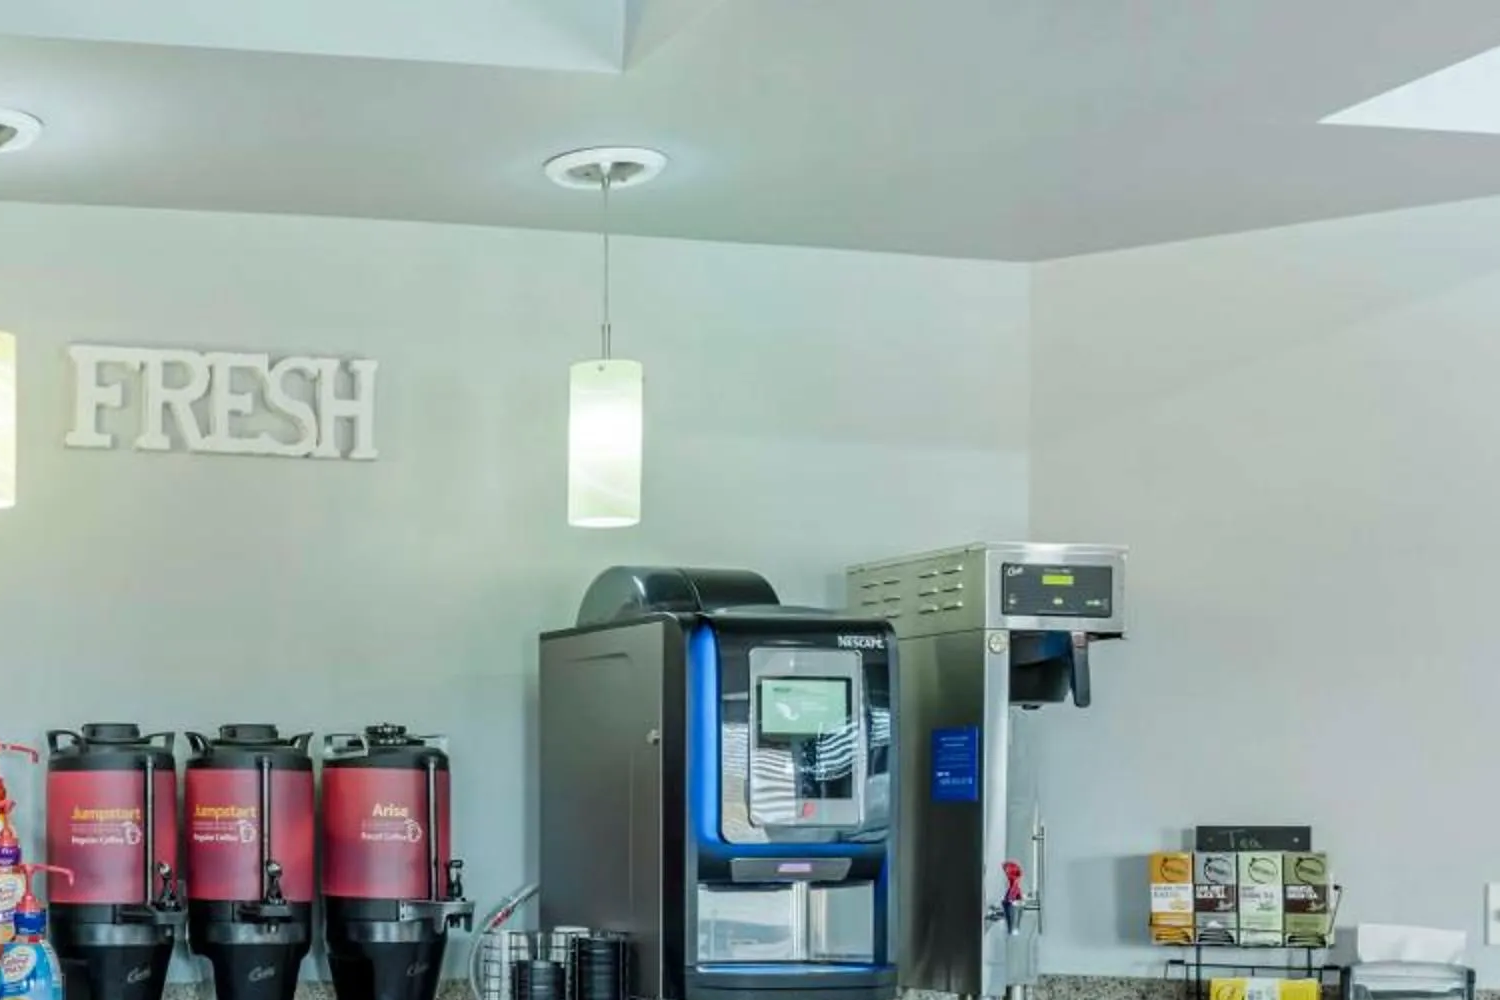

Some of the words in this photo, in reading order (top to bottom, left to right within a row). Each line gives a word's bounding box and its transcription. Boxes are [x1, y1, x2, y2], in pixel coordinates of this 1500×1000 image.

[64, 344, 379, 460] FRESH
[71, 805, 141, 822] Jumpstart
[194, 803, 257, 821] Jumpstart
[372, 802, 409, 817] Arise
[1218, 828, 1263, 849] Tea
